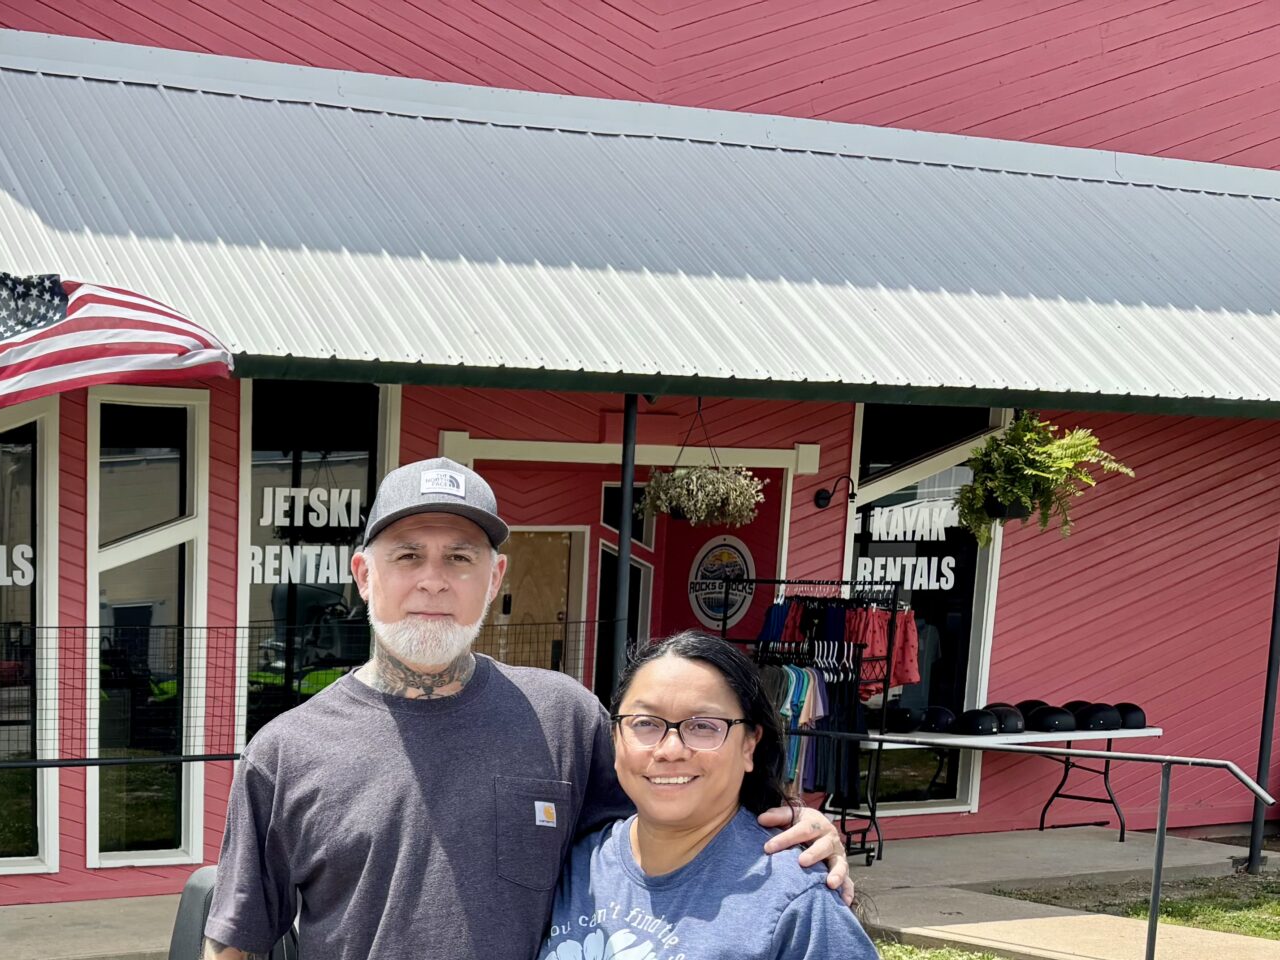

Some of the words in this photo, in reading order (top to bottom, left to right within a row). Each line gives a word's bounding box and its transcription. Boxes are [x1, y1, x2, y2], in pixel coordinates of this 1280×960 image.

[260, 487, 361, 528] JETSKI
[871, 507, 947, 541] KAYAK
[249, 545, 363, 584] RENTAL
[857, 556, 956, 591] RENTALS
[689, 581, 716, 595] ROCKS
[578, 902, 620, 928] can't
[624, 908, 664, 934] find
